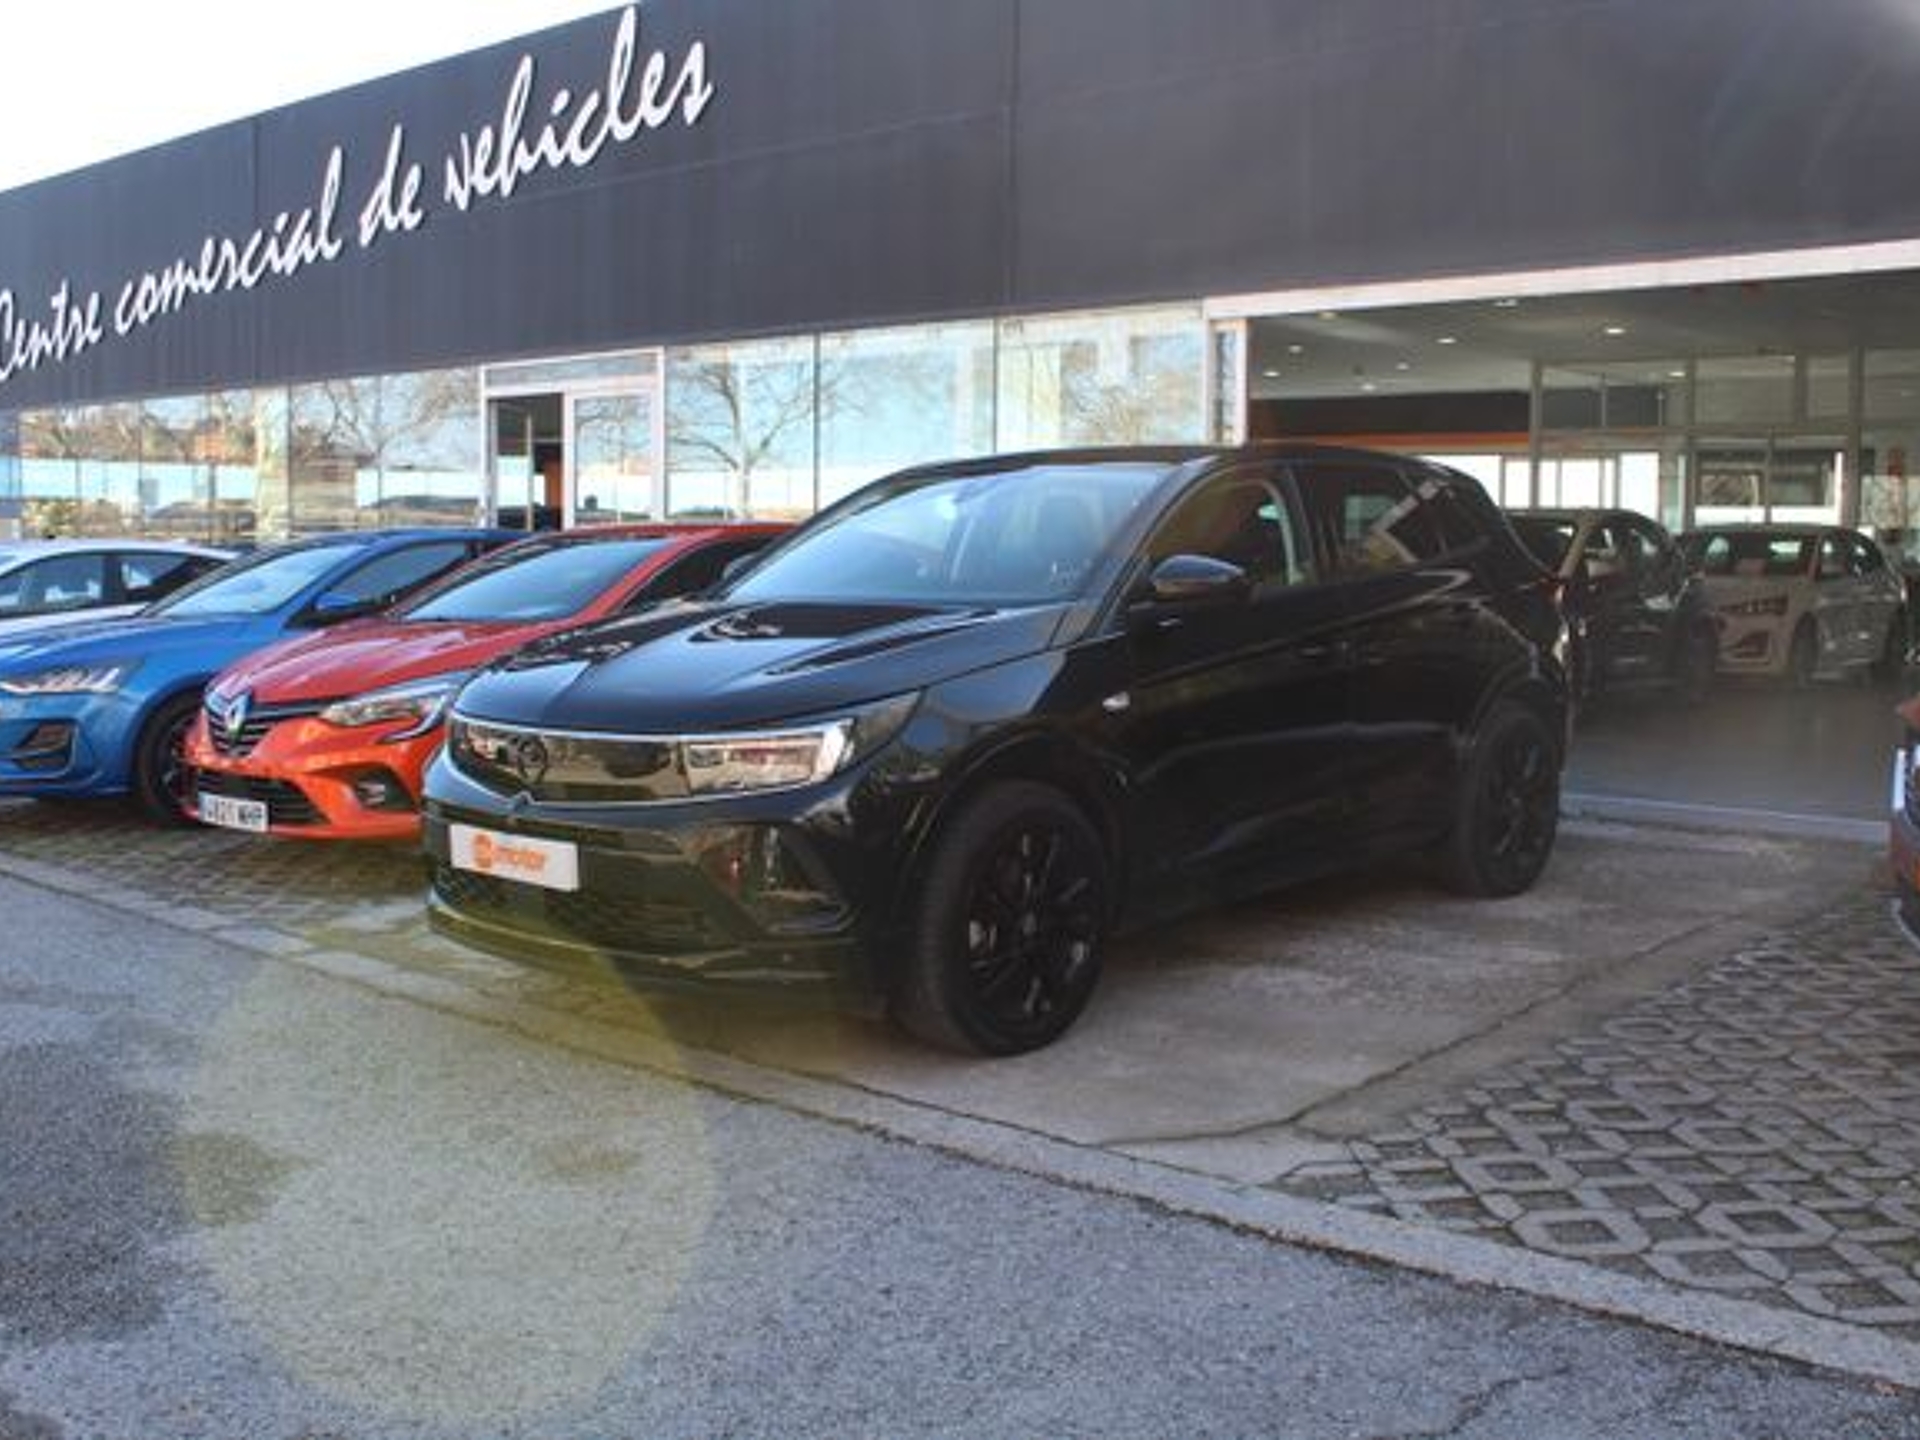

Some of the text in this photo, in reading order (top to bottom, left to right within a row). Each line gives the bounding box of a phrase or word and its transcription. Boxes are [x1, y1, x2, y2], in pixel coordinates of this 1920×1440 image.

[115, 147, 342, 335] comercial
[360, 125, 423, 247] de
[445, 6, 712, 211] vehicles
